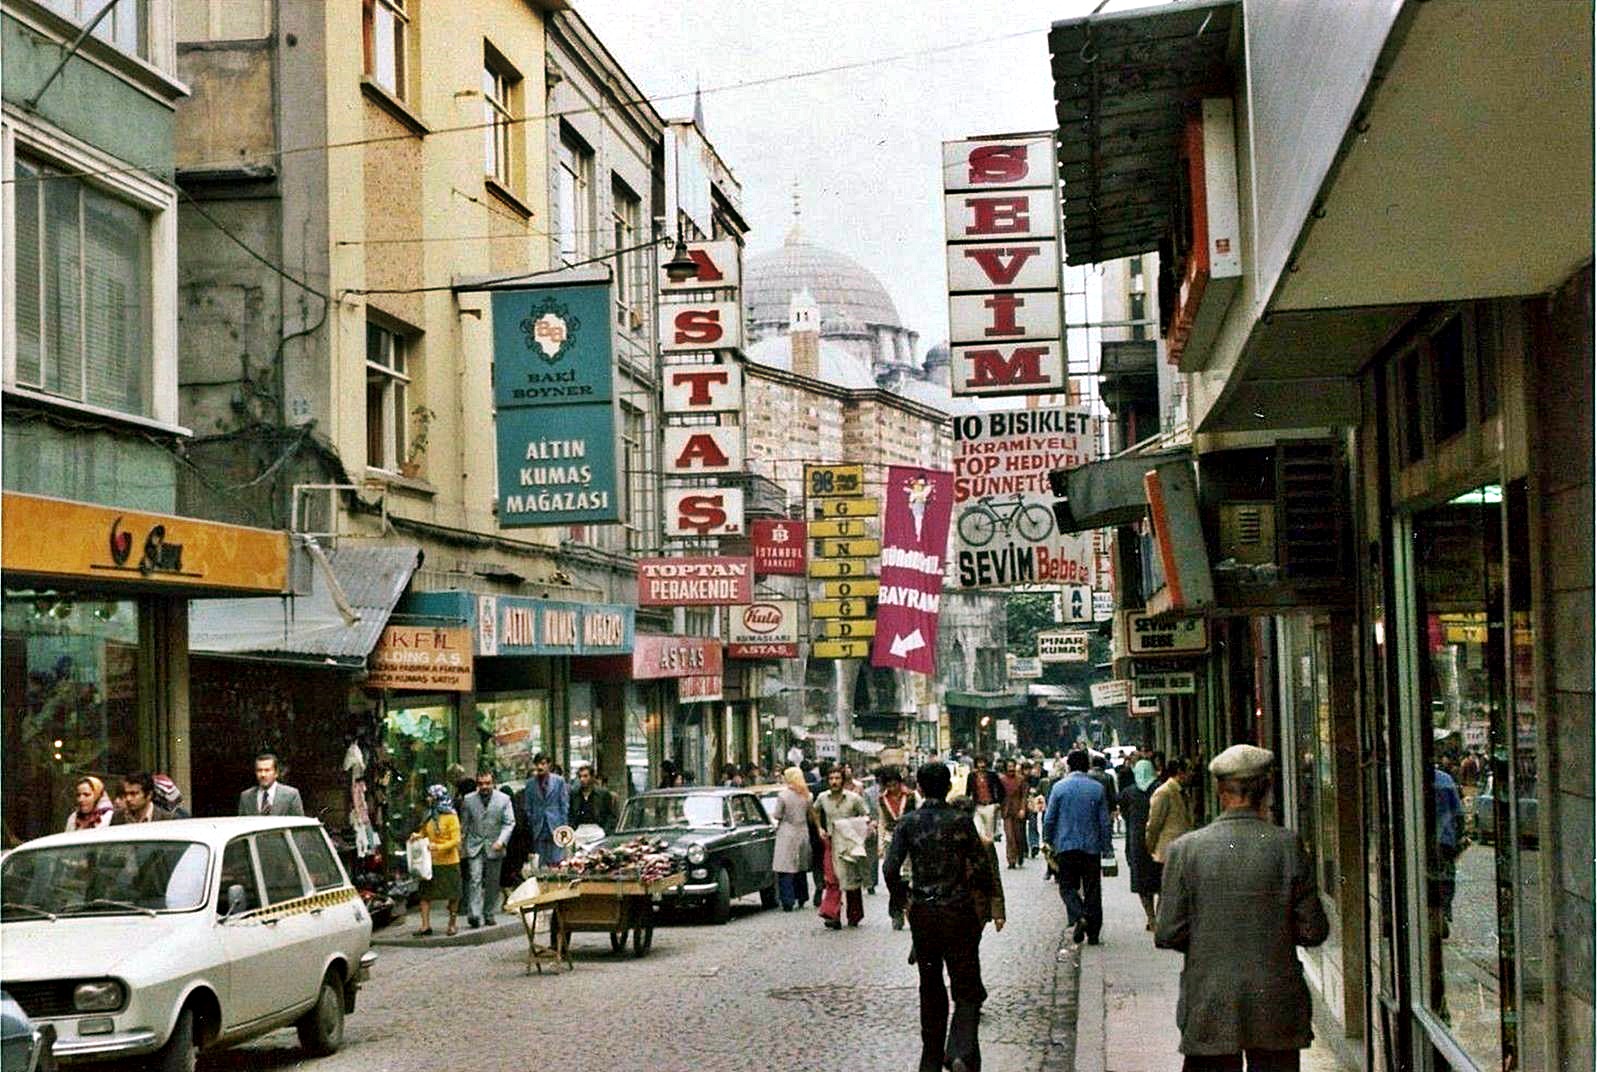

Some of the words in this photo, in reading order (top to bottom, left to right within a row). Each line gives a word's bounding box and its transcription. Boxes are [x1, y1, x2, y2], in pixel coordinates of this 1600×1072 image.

[512, 385, 593, 398] BOYNER
[526, 440, 585, 459] ALTIN
[962, 436, 1078, 455] İKRAMİYELİ
[953, 456, 1000, 476] TOP
[520, 465, 592, 487] KUMAŞ
[506, 490, 609, 513] MAĞAZASI
[642, 563, 747, 578] TOPTAN
[959, 542, 1033, 587] SEVİM
[1036, 546, 1077, 580] Bebe
[650, 580, 738, 600] PERAKENDE
[878, 586, 940, 613] BAYRAM
[746, 609, 782, 625] Kula
[1041, 637, 1083, 645] PINAR
